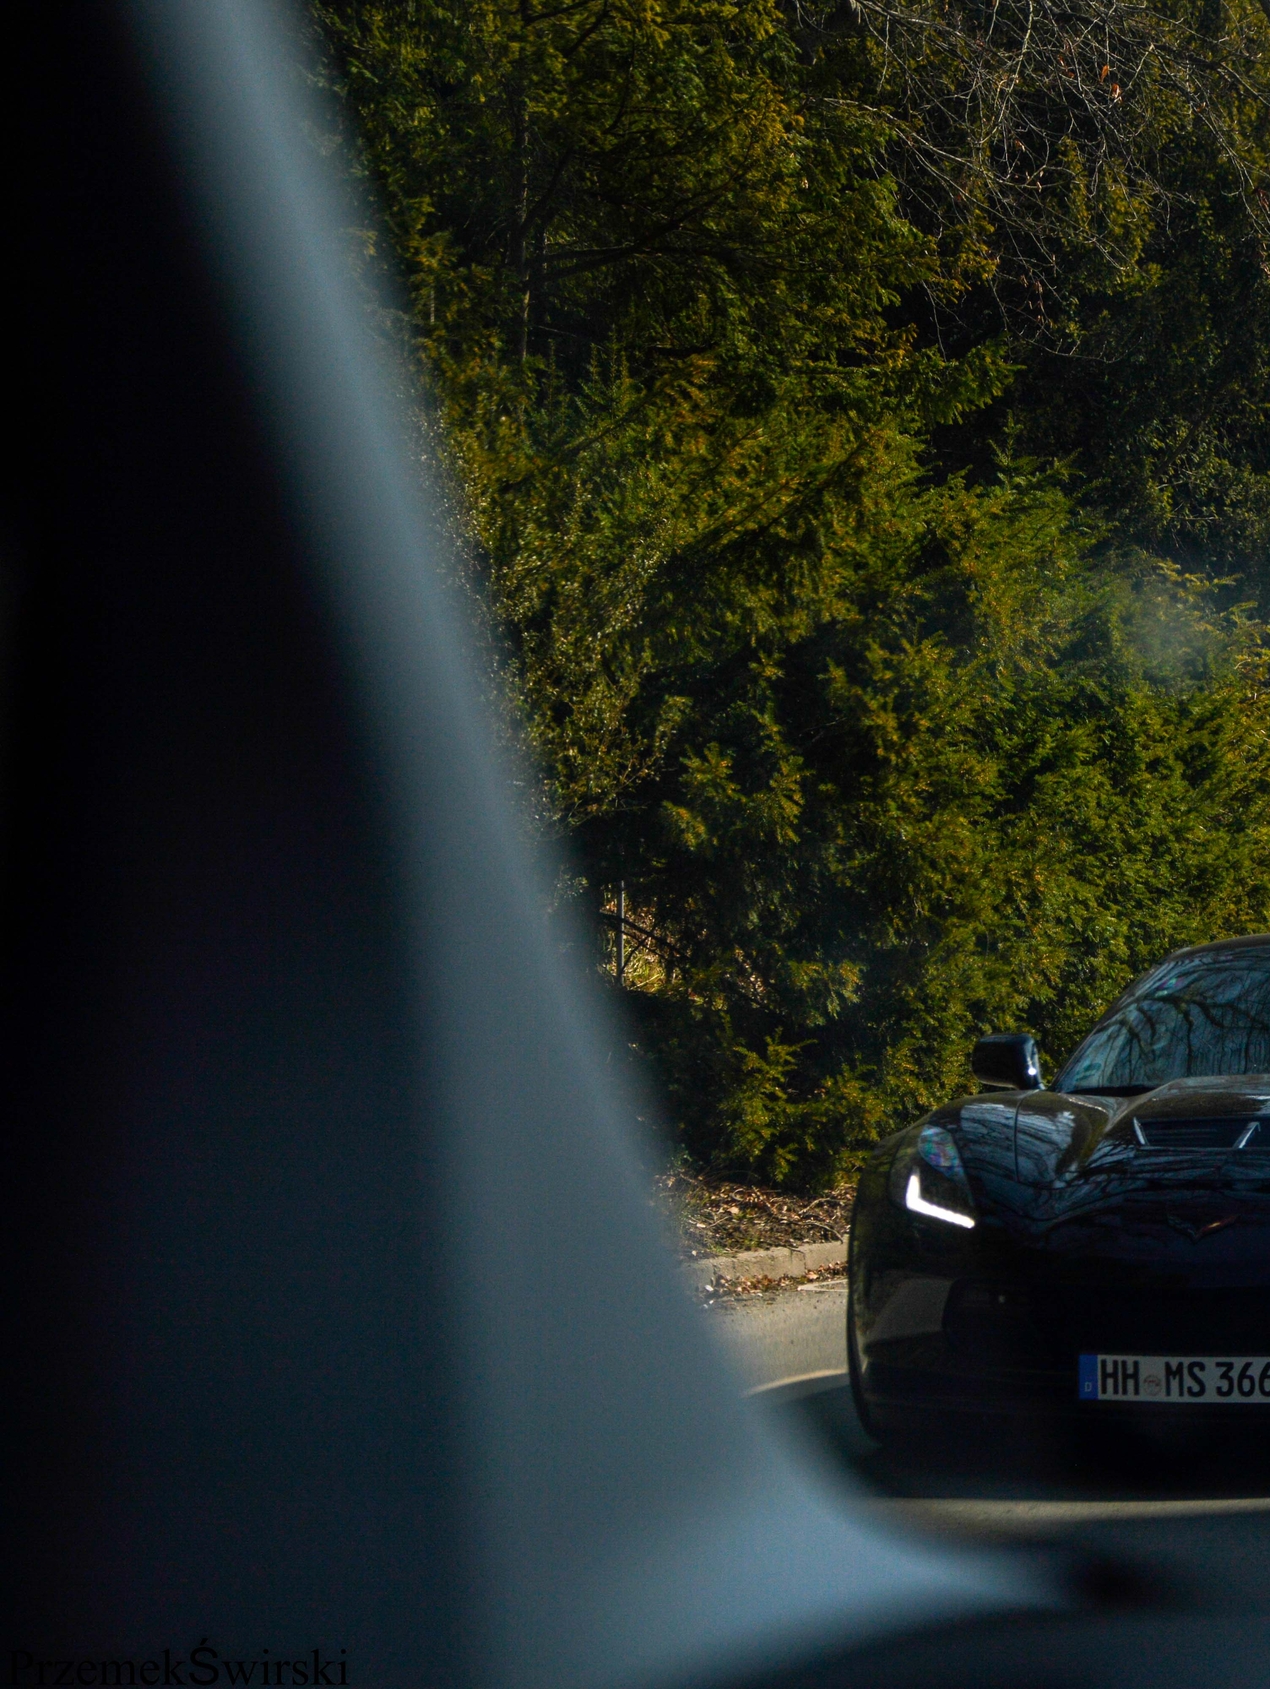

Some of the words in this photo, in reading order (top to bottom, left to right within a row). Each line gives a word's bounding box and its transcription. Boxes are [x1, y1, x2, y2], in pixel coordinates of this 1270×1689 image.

[1084, 1381, 1092, 1392] D
[1100, 1358, 1140, 1396] HH
[1164, 1361, 1206, 1398] MS
